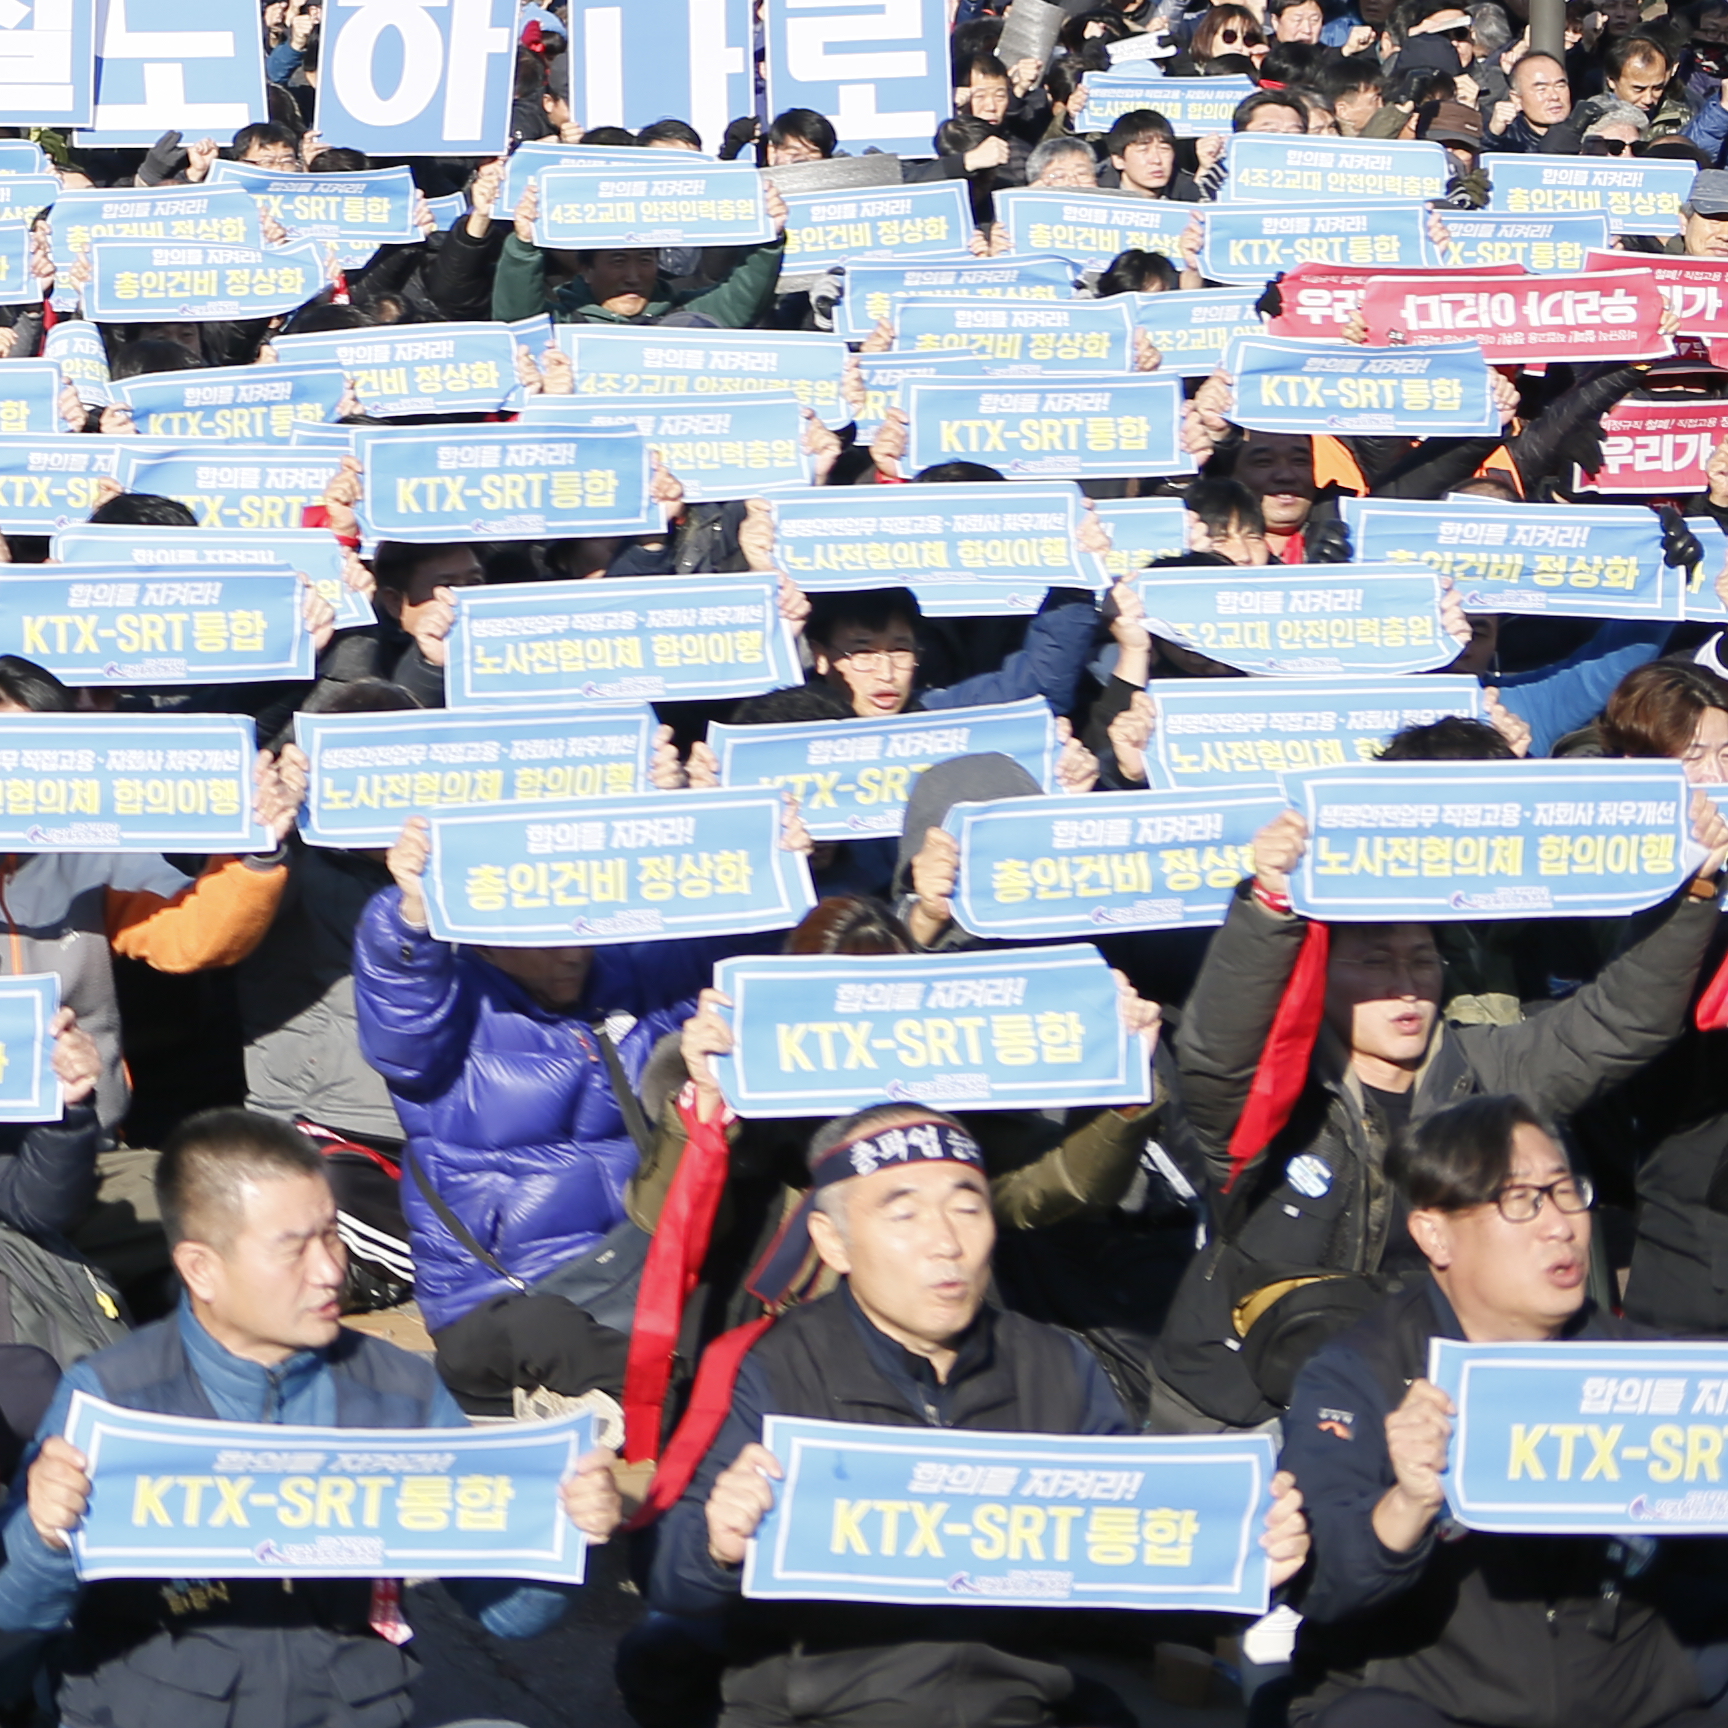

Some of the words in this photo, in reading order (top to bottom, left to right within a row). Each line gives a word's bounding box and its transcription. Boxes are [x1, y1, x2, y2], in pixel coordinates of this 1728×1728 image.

[112, 778, 240, 817] 합의이행
[1314, 834, 1525, 877] 노사전협의체
[1537, 834, 1676, 877] 합의이행
[908, 1462, 1019, 1497] 합의를
